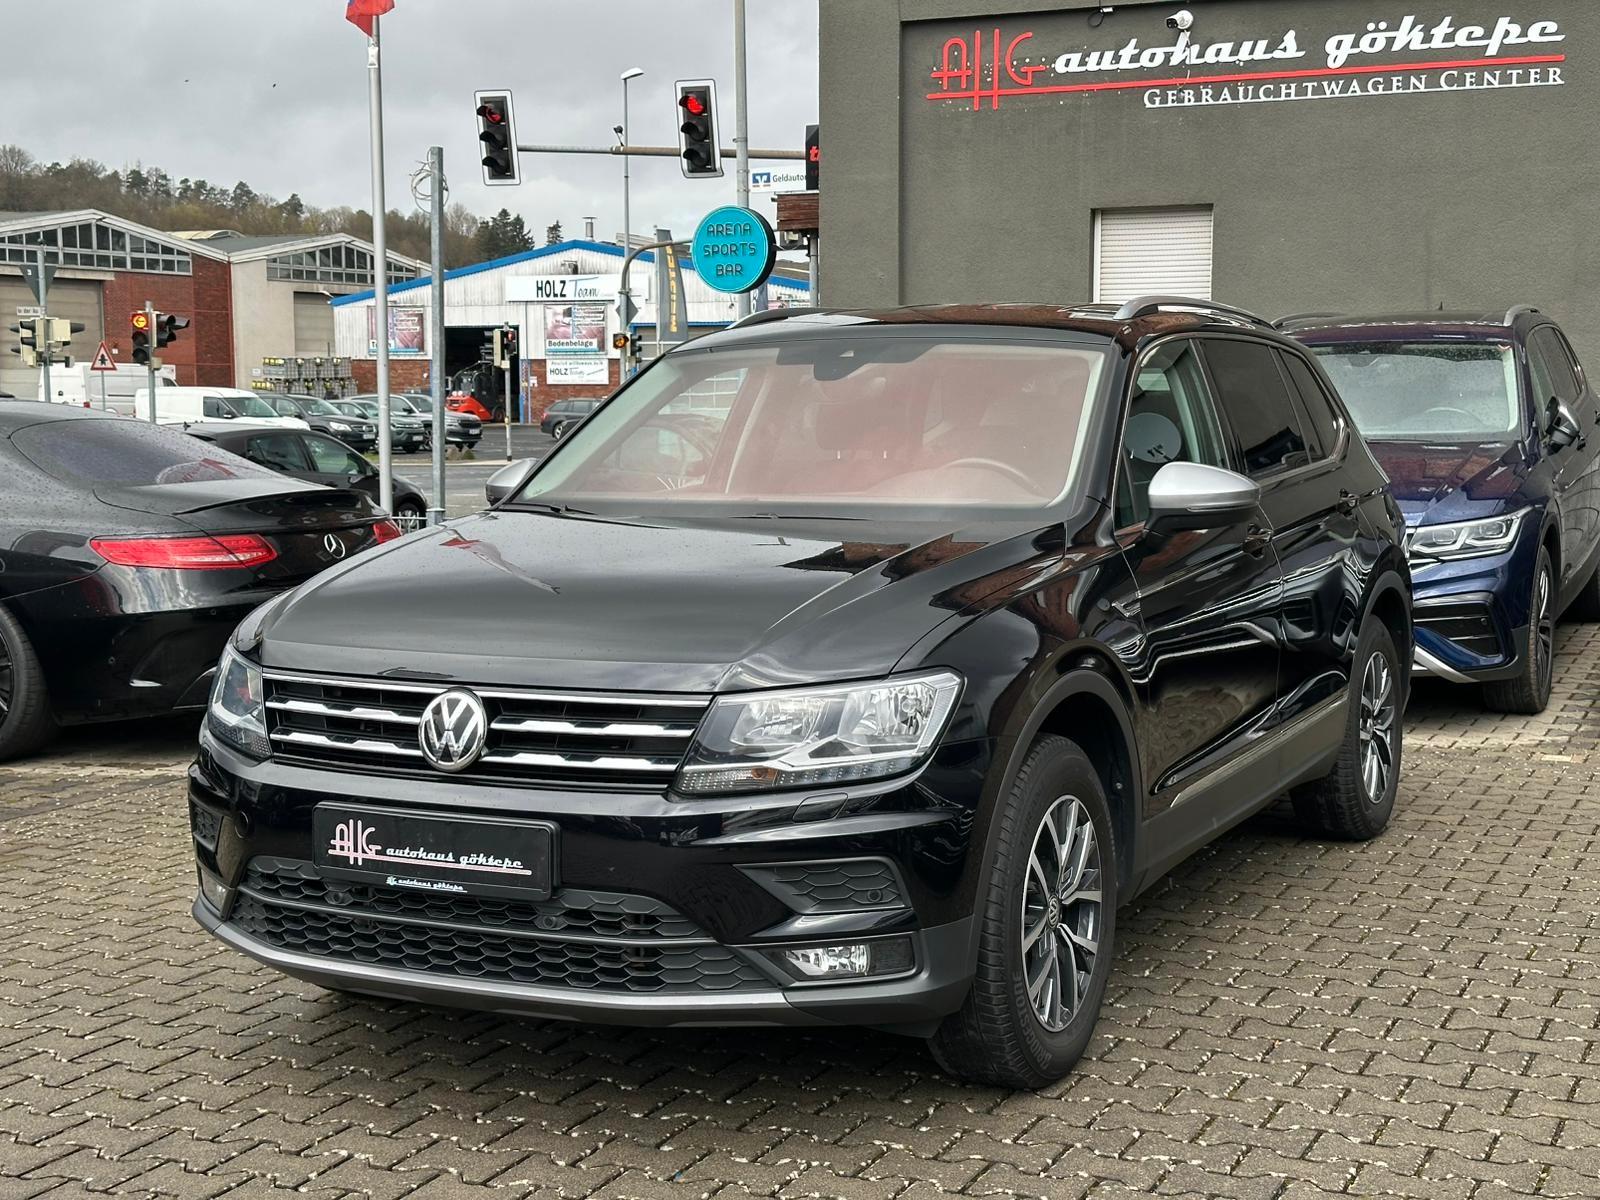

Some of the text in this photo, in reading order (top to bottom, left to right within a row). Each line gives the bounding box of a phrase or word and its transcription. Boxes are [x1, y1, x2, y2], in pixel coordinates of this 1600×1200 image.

[1055, 29, 1305, 74] autohaus
[1325, 15, 1566, 69] göktepe
[1143, 67, 1565, 108] GEBRAUCHTWAGEN CENTER
[772, 174, 807, 183] Geldauto
[706, 222, 752, 238] ARENA
[703, 242, 757, 257] SPORTS
[715, 263, 744, 277] BAR
[536, 276, 600, 299] HOLZ Team
[549, 367, 569, 376] HOLZ
[421, 692, 485, 766] VW
[386, 847, 456, 863] autohaus
[459, 853, 524, 871] göktepe
